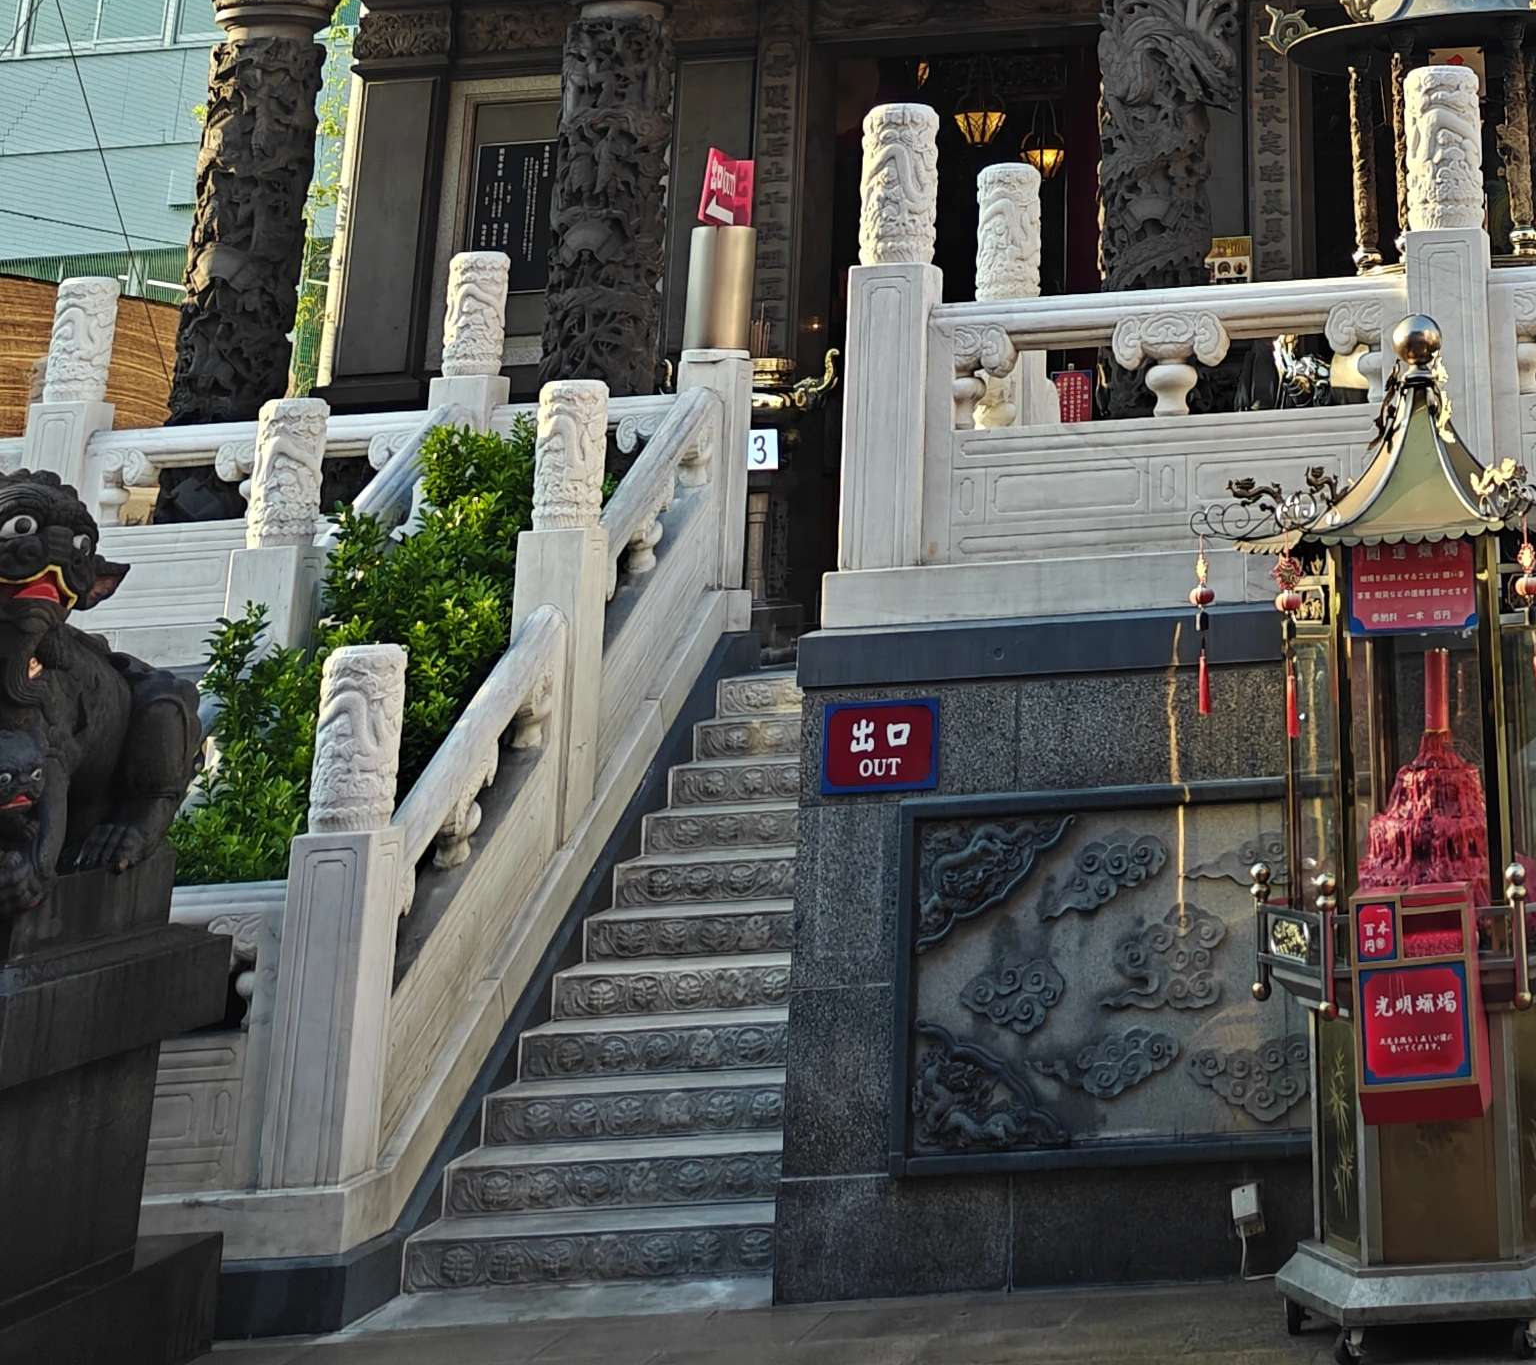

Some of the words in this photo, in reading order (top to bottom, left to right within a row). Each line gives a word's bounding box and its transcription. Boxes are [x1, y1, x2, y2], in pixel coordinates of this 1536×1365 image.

[753, 434, 767, 465] 3
[1433, 610, 1451, 620] 百円
[849, 718, 911, 753] 出口
[858, 758, 902, 777] OUT
[1363, 923, 1376, 953] 百円
